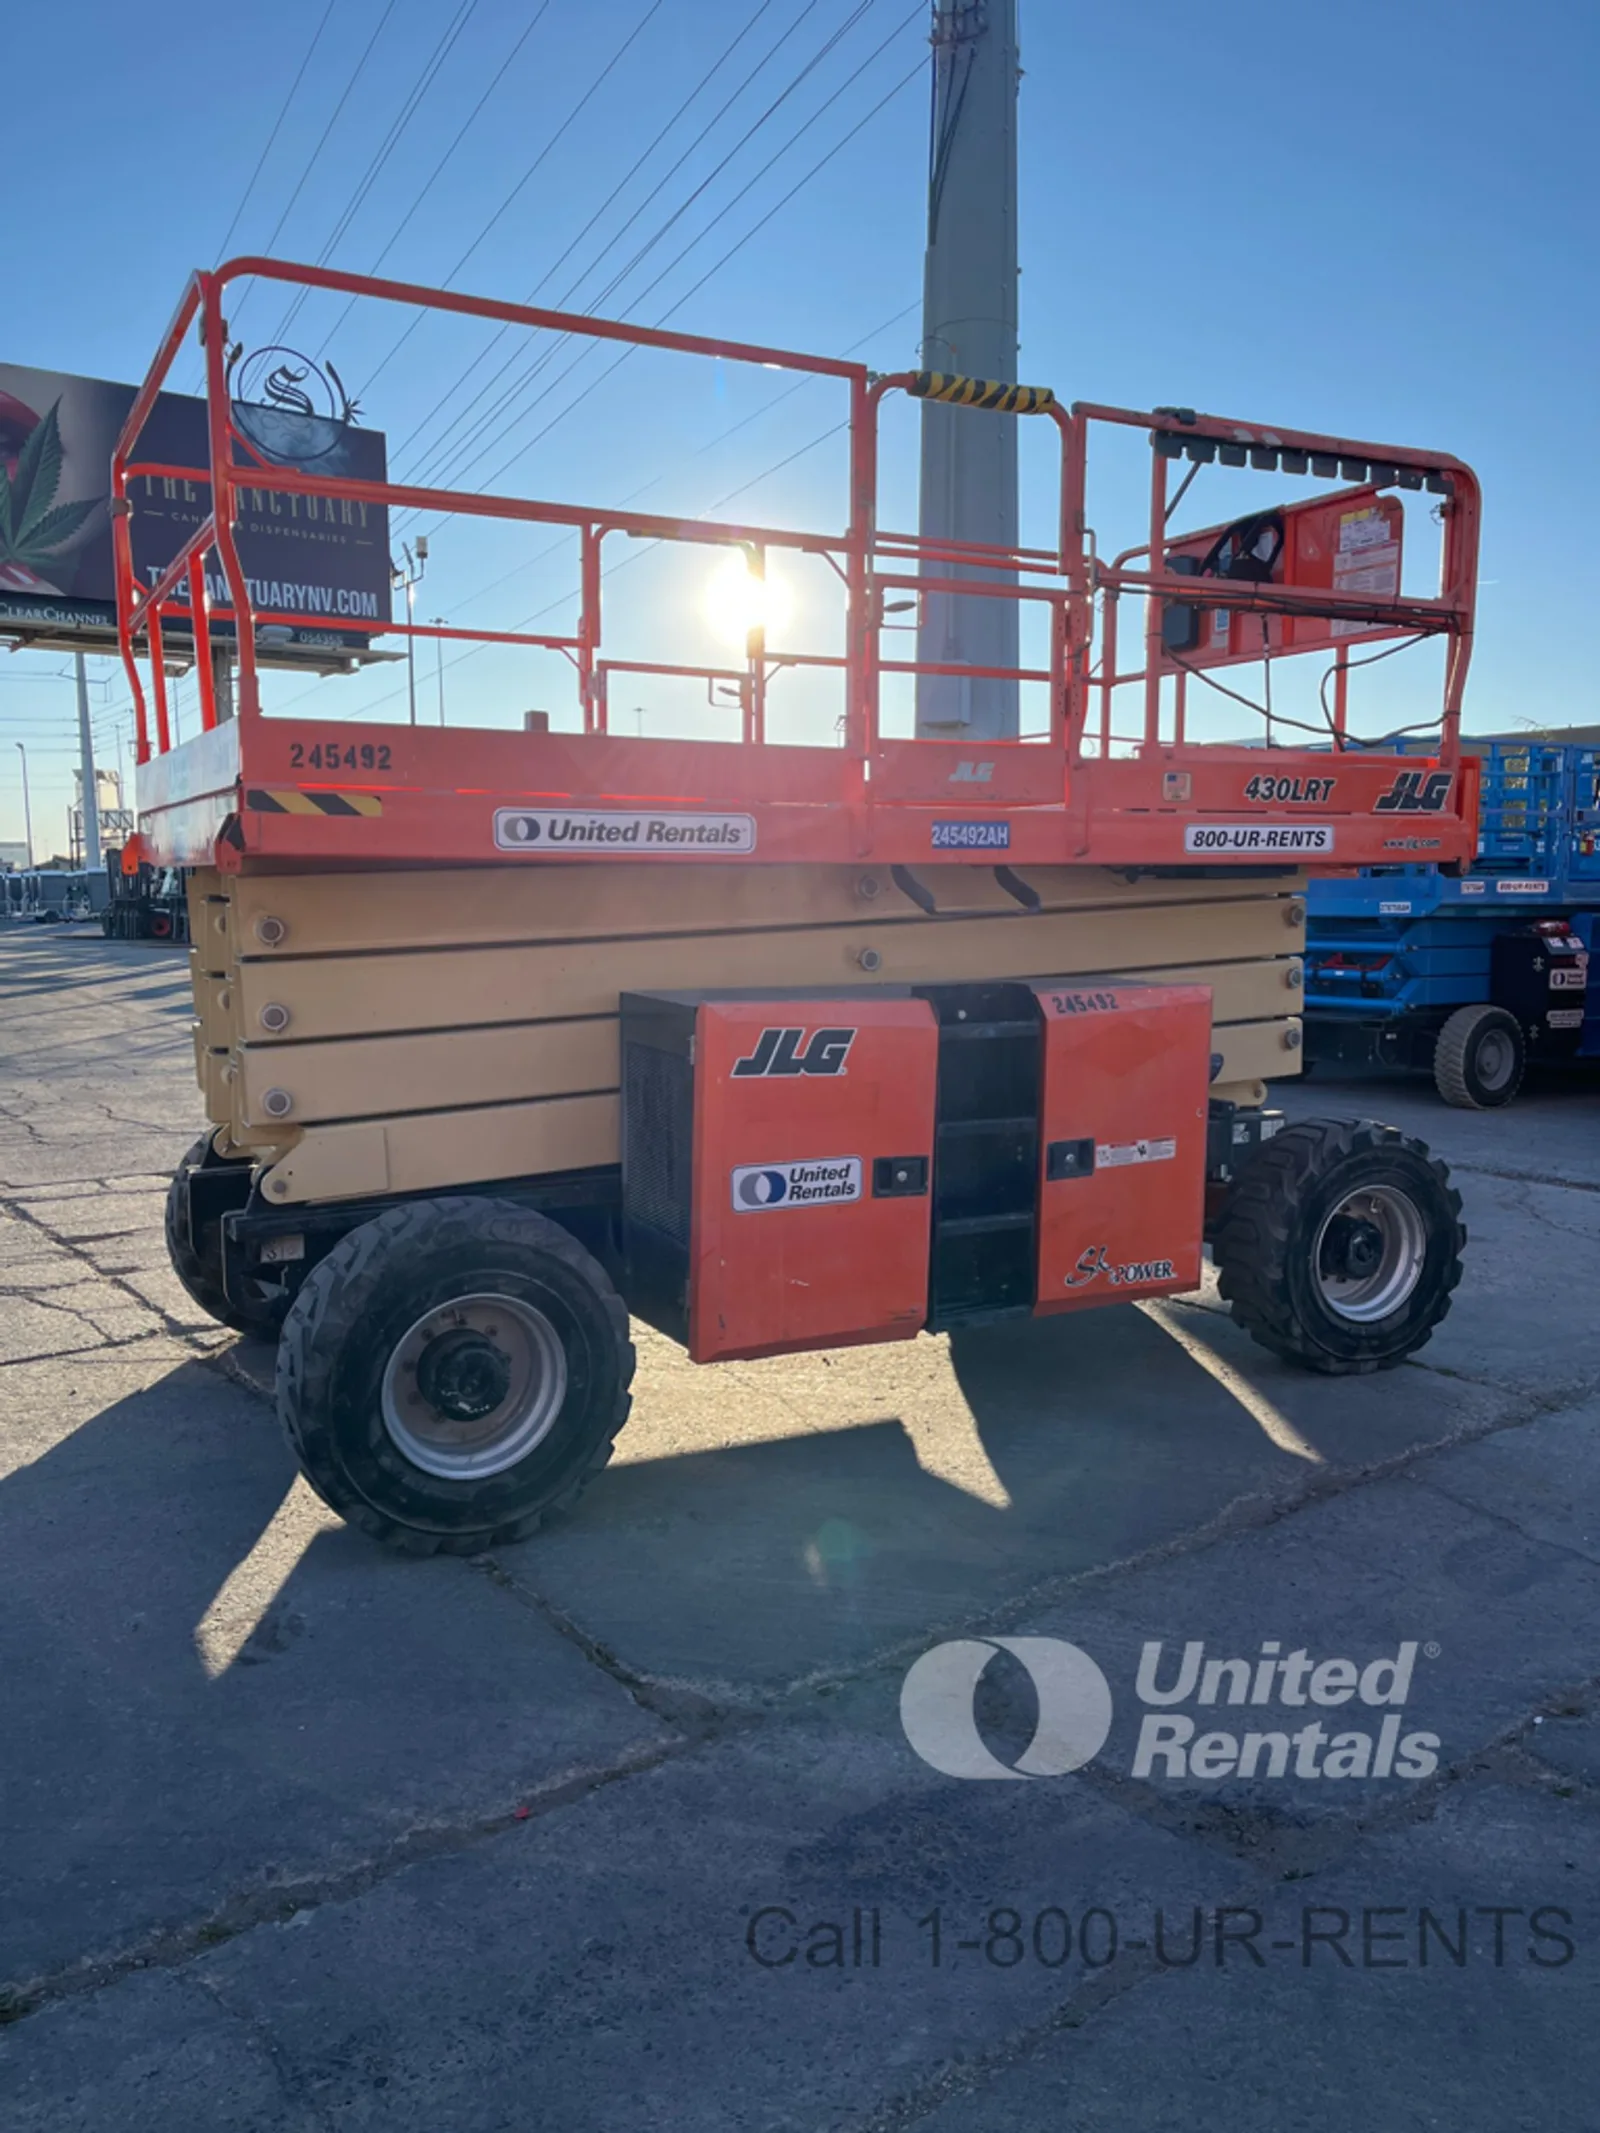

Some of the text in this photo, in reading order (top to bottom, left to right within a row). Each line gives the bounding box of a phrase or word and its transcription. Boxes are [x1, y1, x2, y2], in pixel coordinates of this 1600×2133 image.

[235, 486, 369, 529] ANCTUARY
[250, 523, 347, 545] DISPENSARIES
[290, 743, 393, 769] 245492
[1245, 775, 1336, 802] 430LRT
[1373, 771, 1453, 812] JLG
[547, 818, 742, 844] United Rentals
[931, 825, 1008, 846] 245492AH
[1192, 829, 1326, 848] 800-UR-RENTS
[730, 1027, 858, 1078] JLG
[789, 1163, 851, 1184] United
[788, 1180, 856, 1202] Rentals
